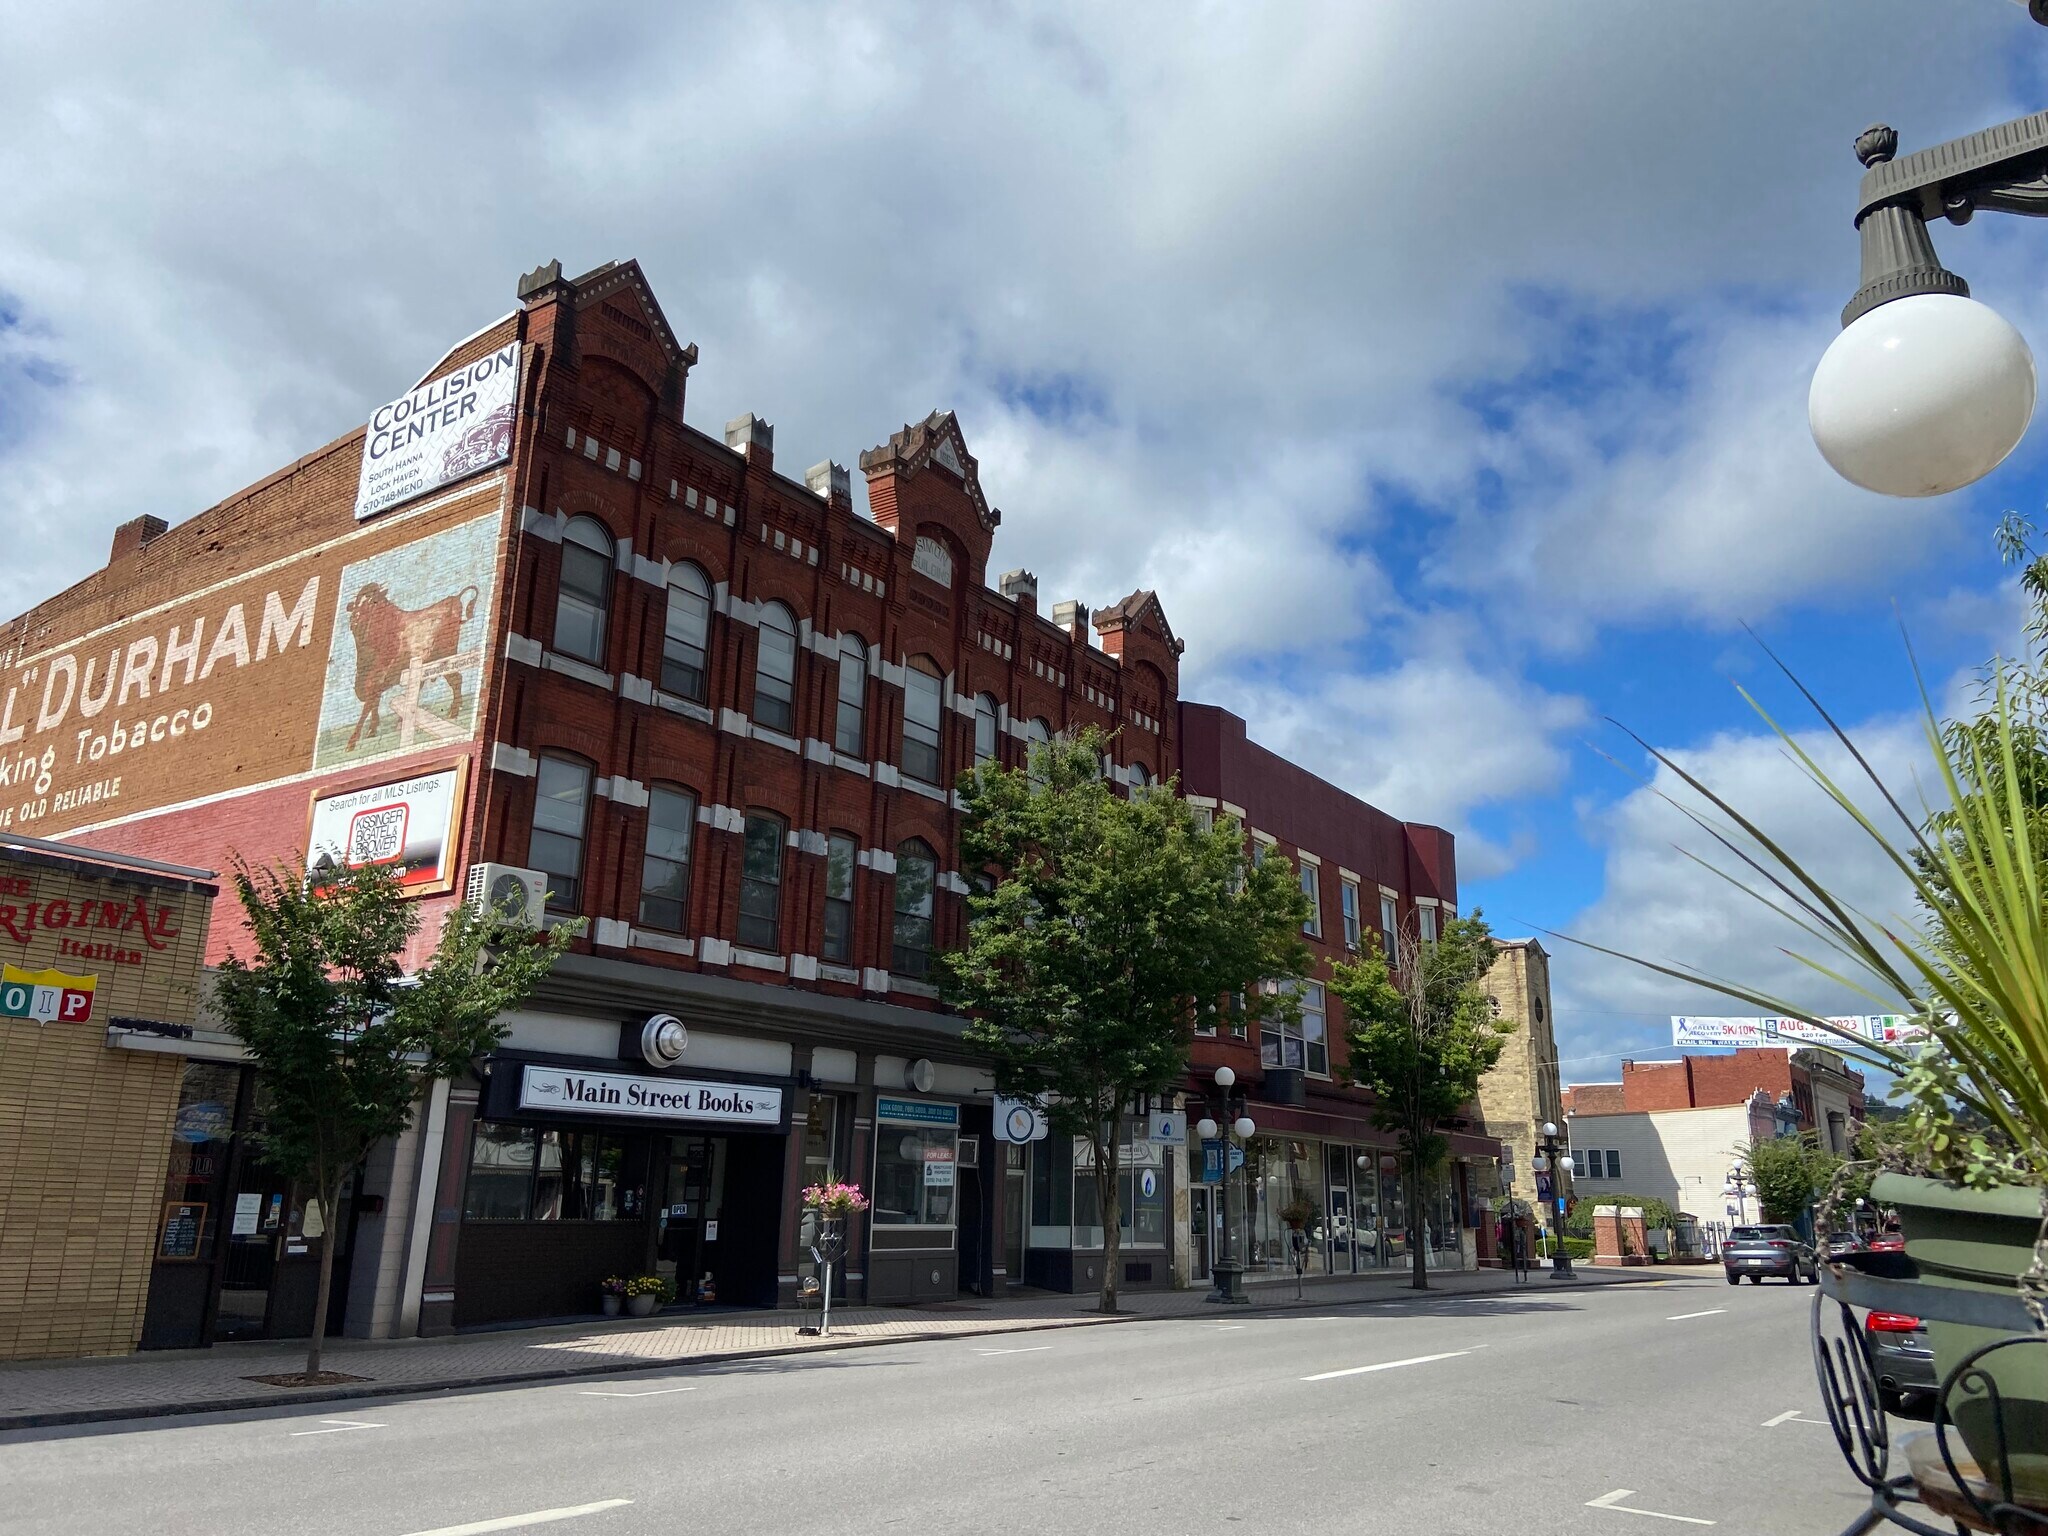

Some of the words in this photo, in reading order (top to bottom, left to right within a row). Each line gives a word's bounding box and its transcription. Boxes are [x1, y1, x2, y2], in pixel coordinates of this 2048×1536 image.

[373, 345, 516, 433] COLLISION
[369, 391, 478, 460] CENTER
[368, 465, 394, 484] SOUTH
[395, 453, 424, 470] HANNA
[370, 480, 392, 496] LOCK
[392, 467, 420, 485] HAVEN
[916, 538, 949, 567] SIMON
[912, 554, 950, 585] BUILDING
[36, 575, 321, 733] DURHAM
[76, 702, 213, 764] Tobacco
[20, 796, 47, 821] OLD
[52, 776, 122, 813] RELIABLE
[329, 797, 357, 812] Search
[358, 793, 371, 806] for
[371, 789, 383, 803] all
[384, 785, 405, 800] MLS
[406, 778, 442, 796] Listings.
[355, 809, 404, 830] KISSINGER
[355, 825, 393, 843] BIGATEL
[355, 836, 397, 855] BROWER
[356, 850, 391, 861] RETORS
[59, 938, 143, 966] Italian
[1722, 1025, 1756, 1035] 5K/10K
[1780, 1020, 1808, 1031] AUG.
[1871, 1017, 1883, 1040] WHERE
[562, 1078, 621, 1105] Main
[627, 1084, 692, 1111] Street
[697, 1089, 754, 1114] Books
[673, 1205, 686, 1213] OPEN
